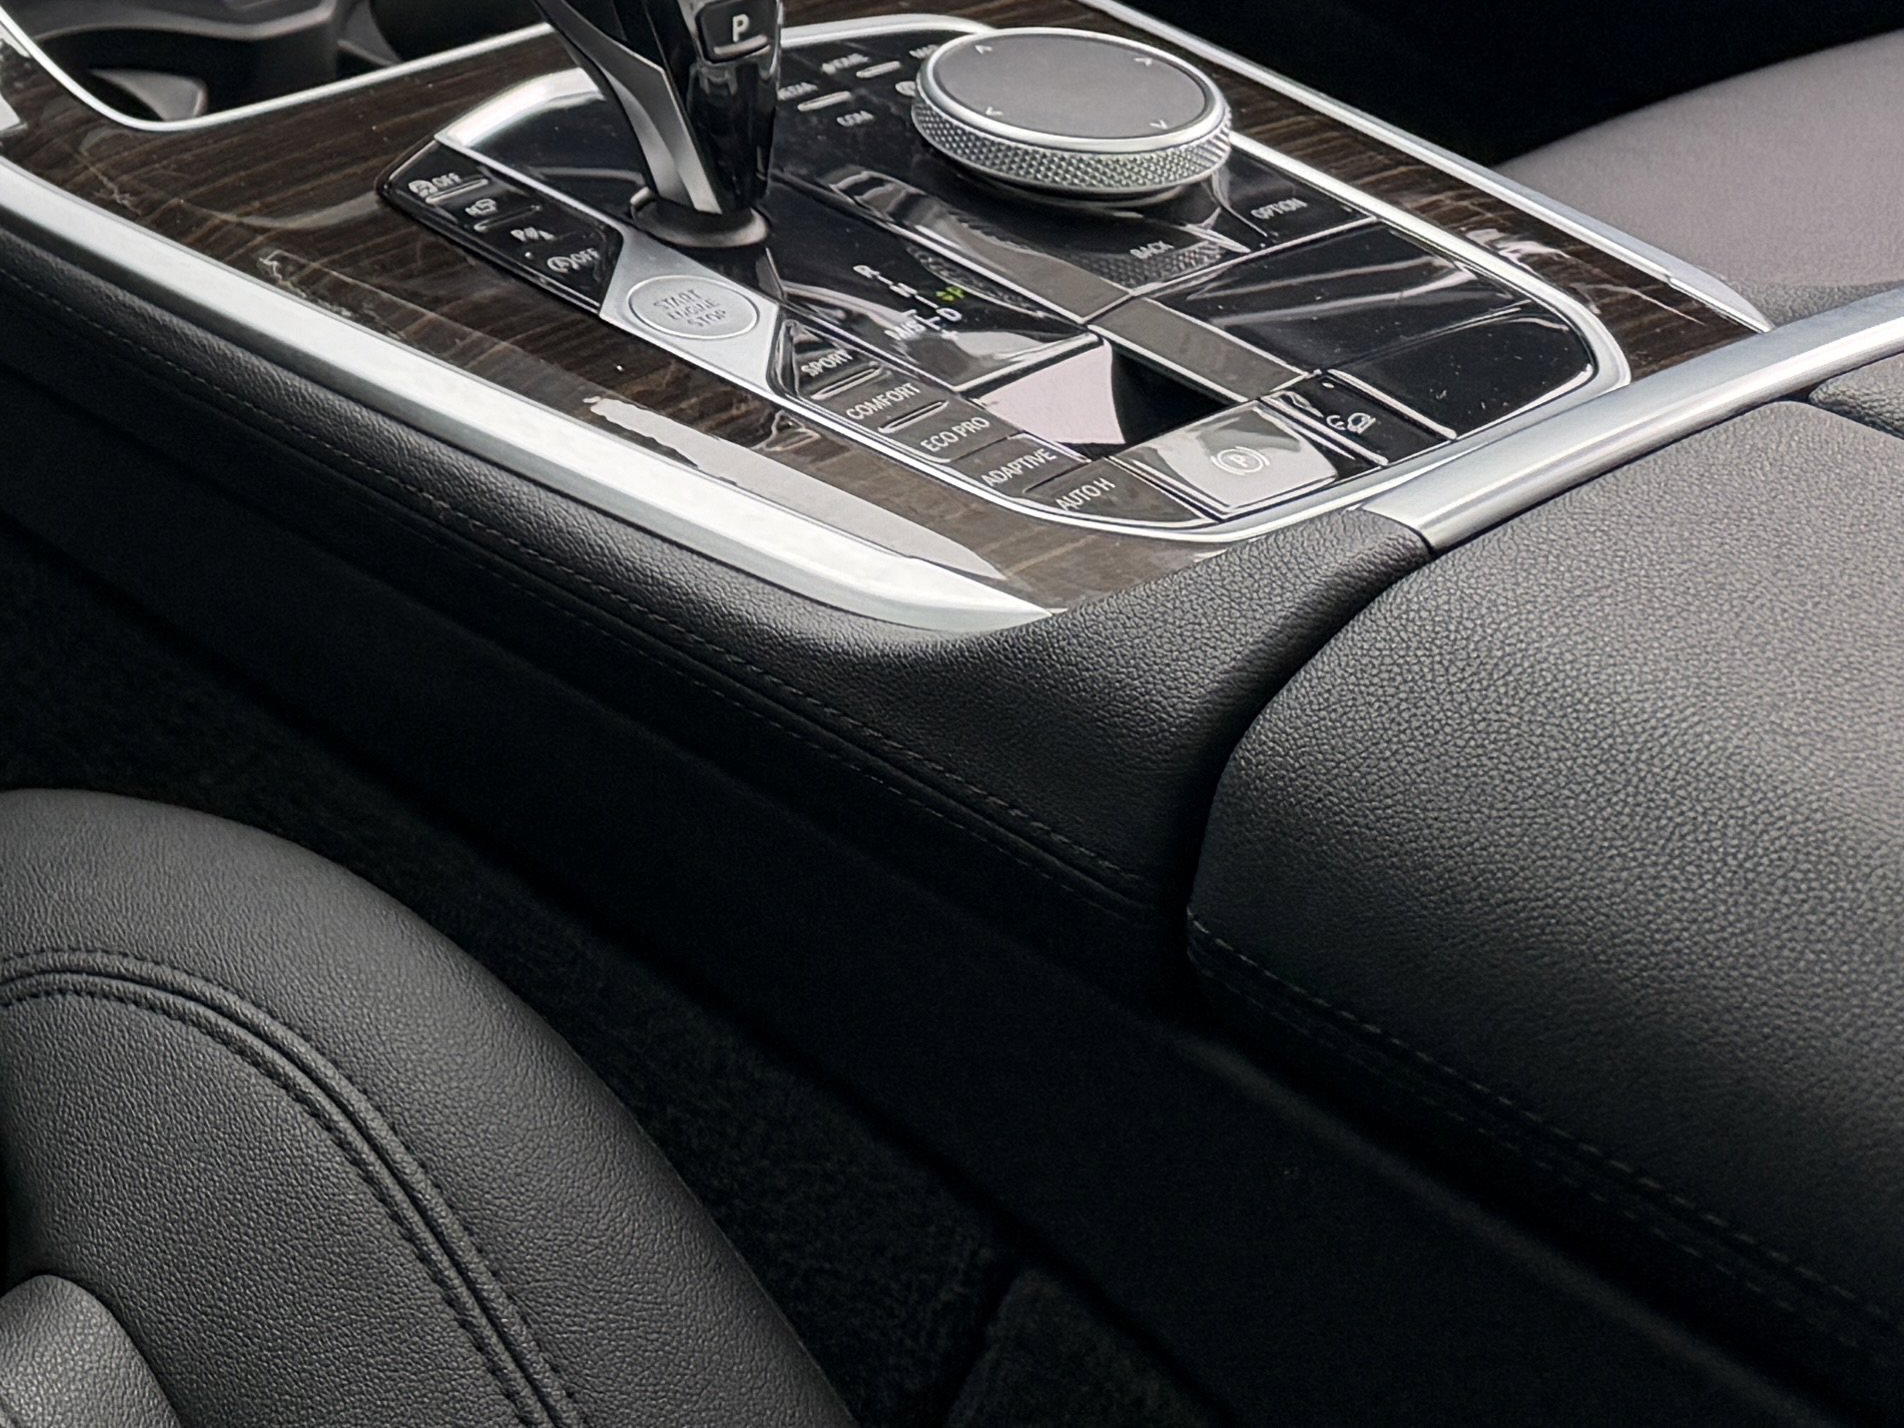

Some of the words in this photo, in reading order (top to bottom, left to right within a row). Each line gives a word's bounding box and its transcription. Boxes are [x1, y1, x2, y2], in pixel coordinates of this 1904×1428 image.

[732, 13, 750, 43] P
[1250, 197, 1309, 221] OPTION
[1129, 240, 1175, 261] BACK
[652, 288, 703, 311] START
[686, 307, 727, 328] STOP
[800, 348, 854, 378] SPORT
[845, 382, 922, 421] COMFORT
[920, 427, 959, 454] ECO
[956, 415, 992, 443] PRO
[980, 447, 1058, 487] ADAPTIVE
[1054, 485, 1096, 513] AUTO
[1092, 477, 1117, 494] H
